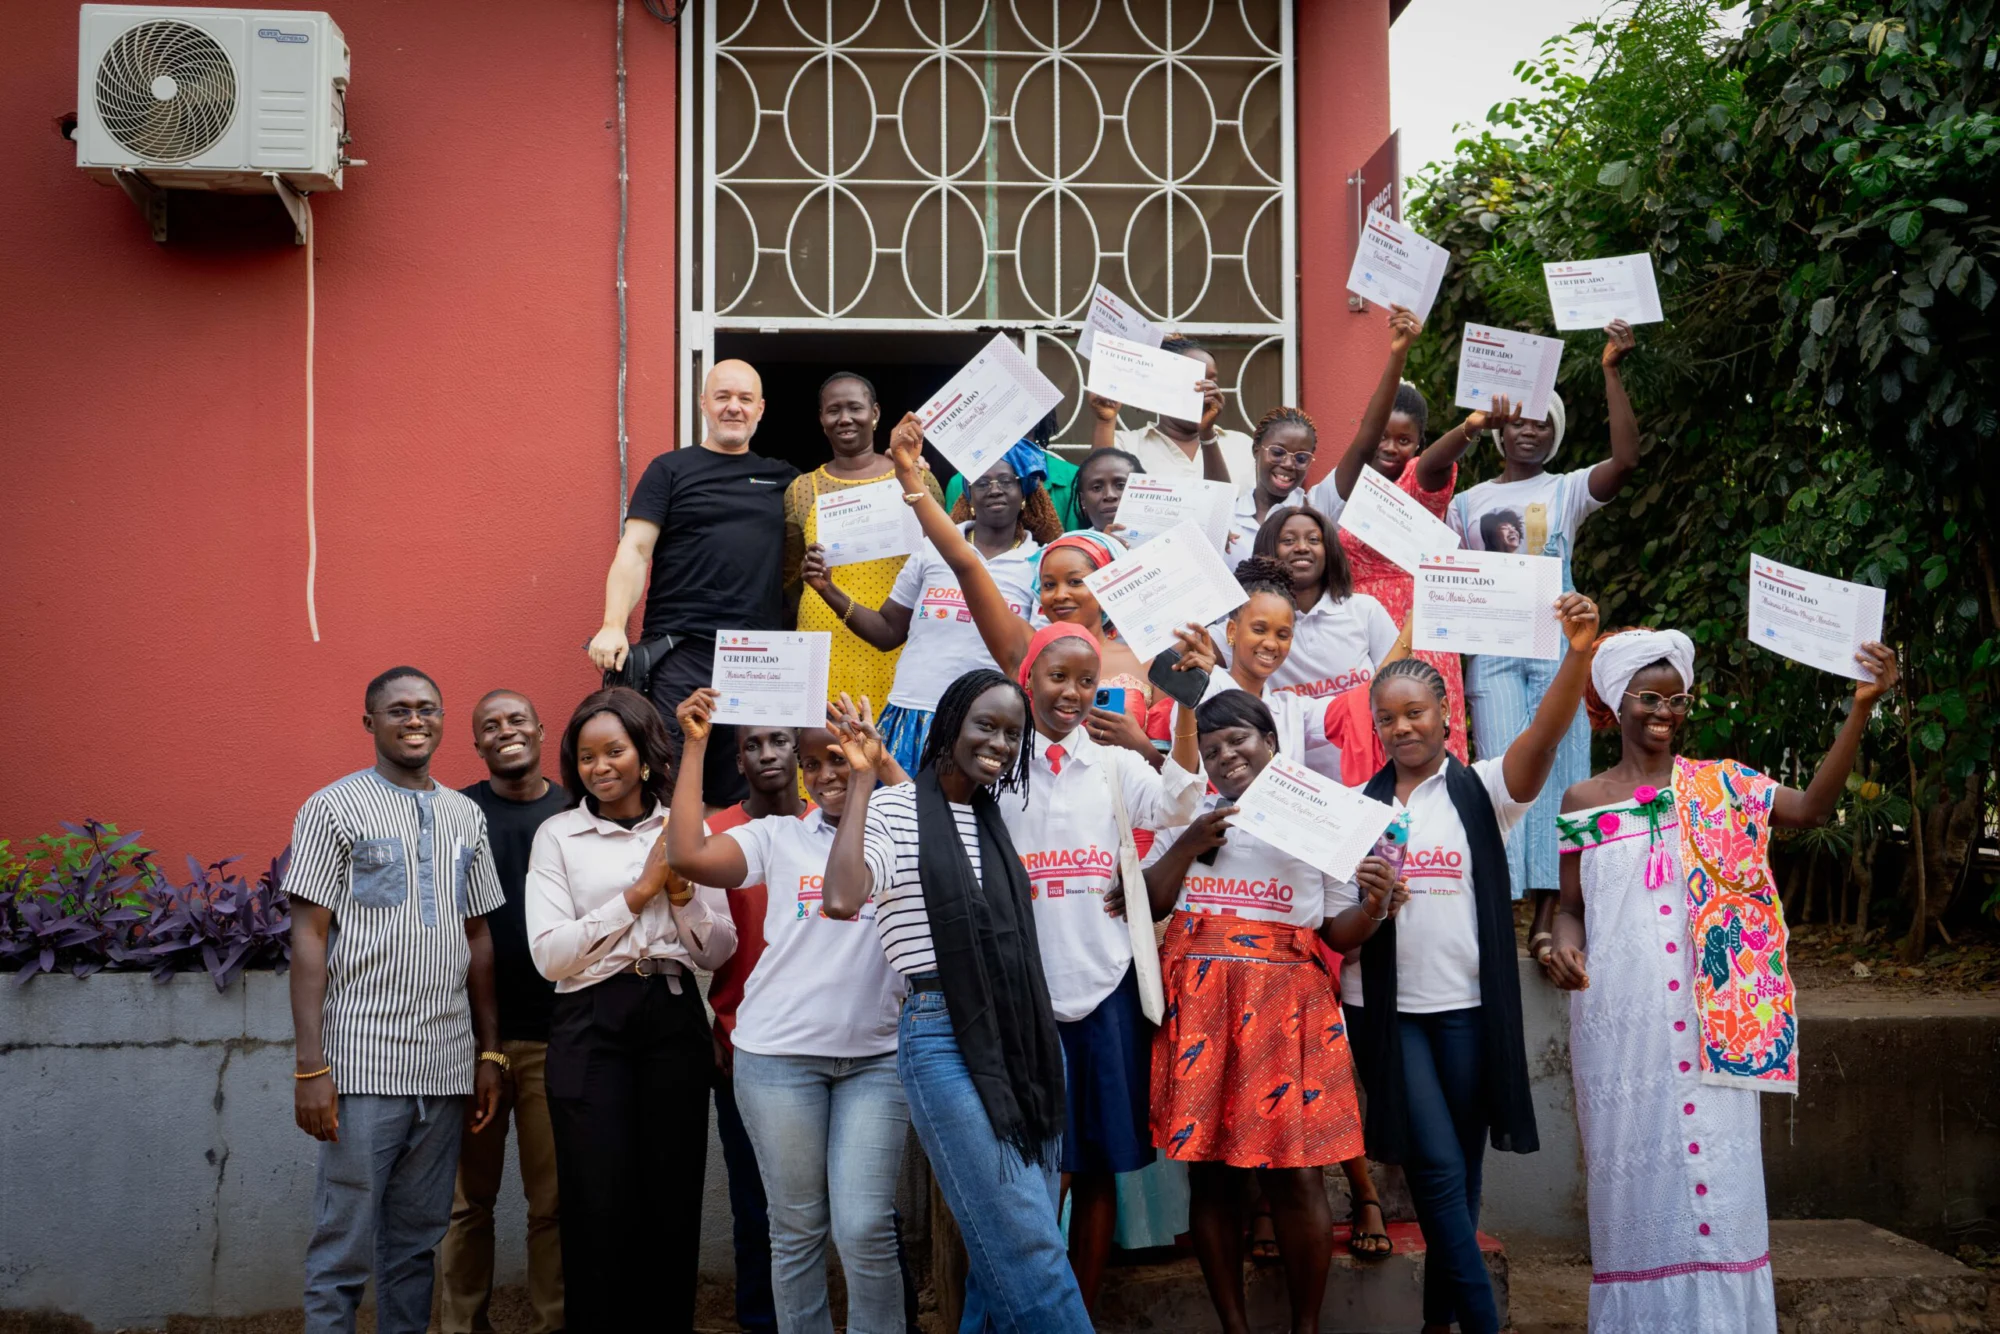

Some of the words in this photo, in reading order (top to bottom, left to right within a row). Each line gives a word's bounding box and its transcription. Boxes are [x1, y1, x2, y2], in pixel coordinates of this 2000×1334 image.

[1368, 232, 1409, 259] CERTIFICADO
[1554, 276, 1605, 287] CERTIFICADO
[1095, 304, 1128, 333] CERTIFICADO
[1100, 348, 1154, 369] CERTIFICADO
[1467, 345, 1513, 360] CERTIFICADO
[932, 389, 980, 435] CERTIFICADO
[1129, 491, 1182, 503] CERTIFICADO
[1364, 483, 1413, 521] CERTIFICADO
[823, 503, 872, 519] CERTIFICADO
[1107, 566, 1162, 603] CERTIFICADO
[1424, 573, 1495, 587] CERTIFICADO
[1758, 579, 1819, 606] CERTIFICADO
[1428, 589, 1445, 603] Rosa
[1445, 590, 1467, 603] Maria
[723, 654, 779, 664] CERTIFICADO
[1272, 667, 1371, 698] RMAÇÃO
[1268, 773, 1328, 808] CERTIFICADO
[1403, 845, 1463, 870] AÇÃO
[1183, 876, 1294, 903] FORMAÇÃO
